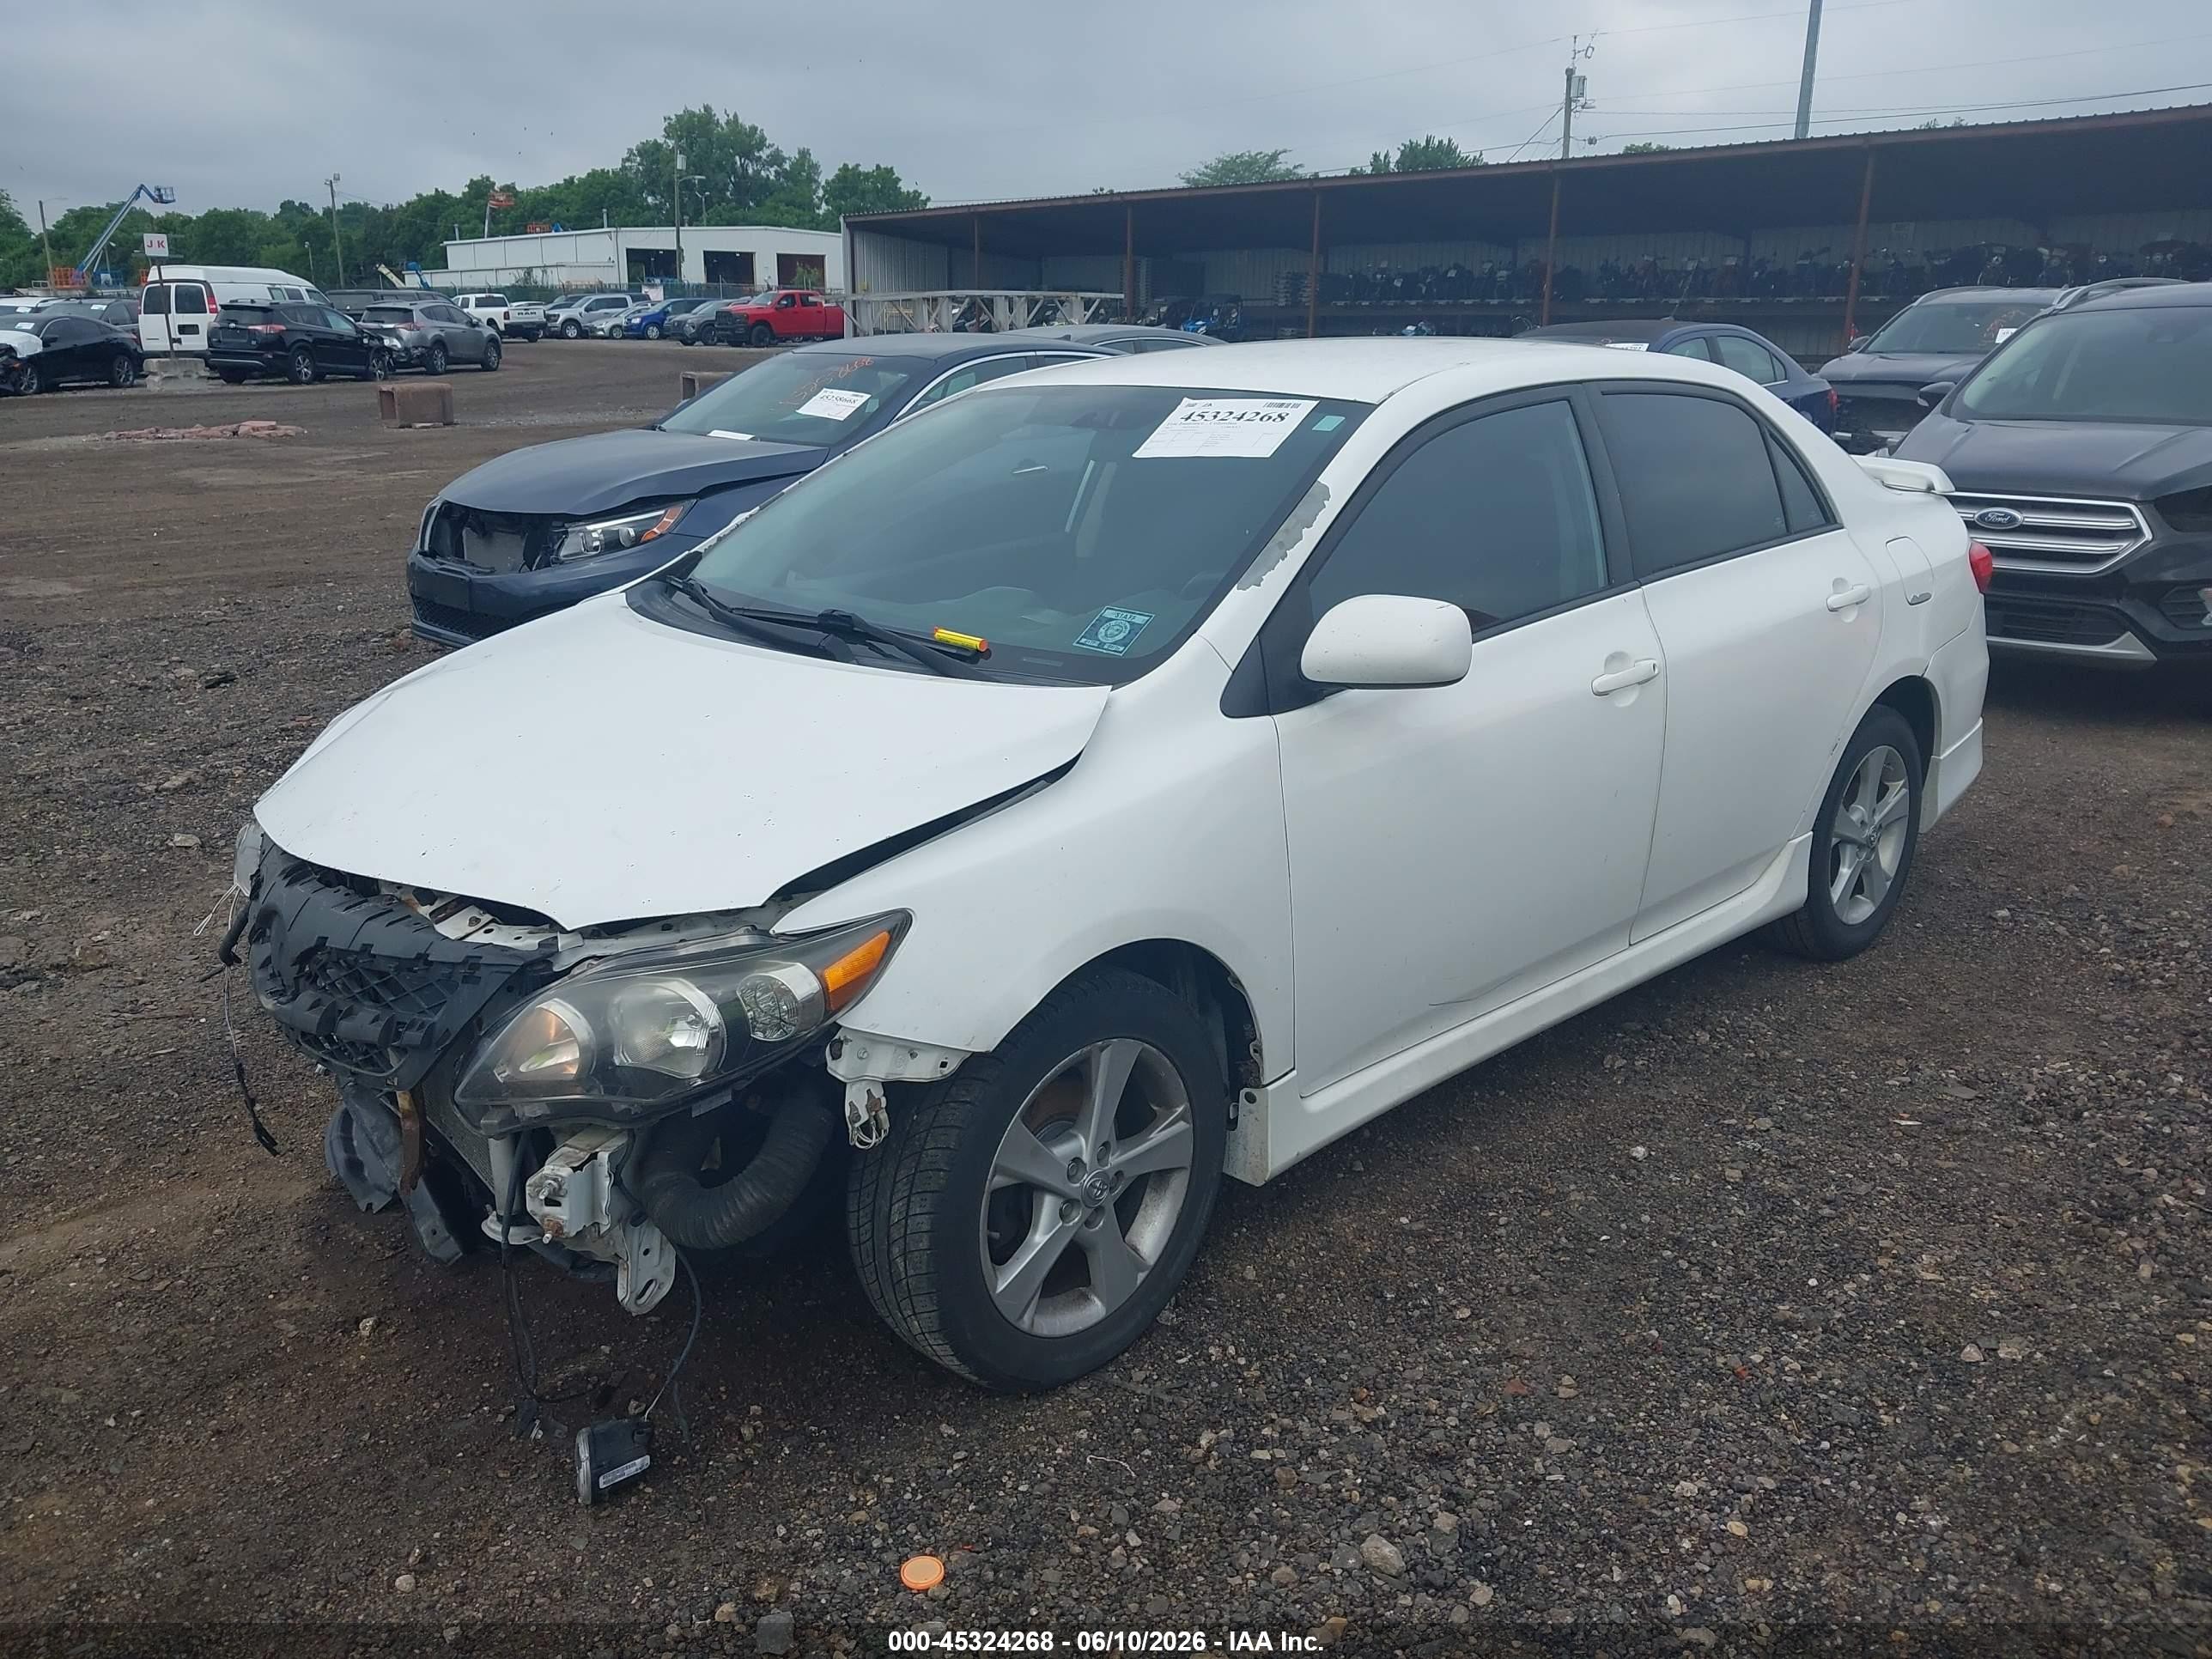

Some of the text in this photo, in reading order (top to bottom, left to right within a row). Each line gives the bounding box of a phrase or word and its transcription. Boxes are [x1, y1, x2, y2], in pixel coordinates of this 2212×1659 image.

[1180, 410, 1291, 424] 45324268
[1984, 512, 2011, 524] Ford
[1115, 612, 1137, 621] STAFF
